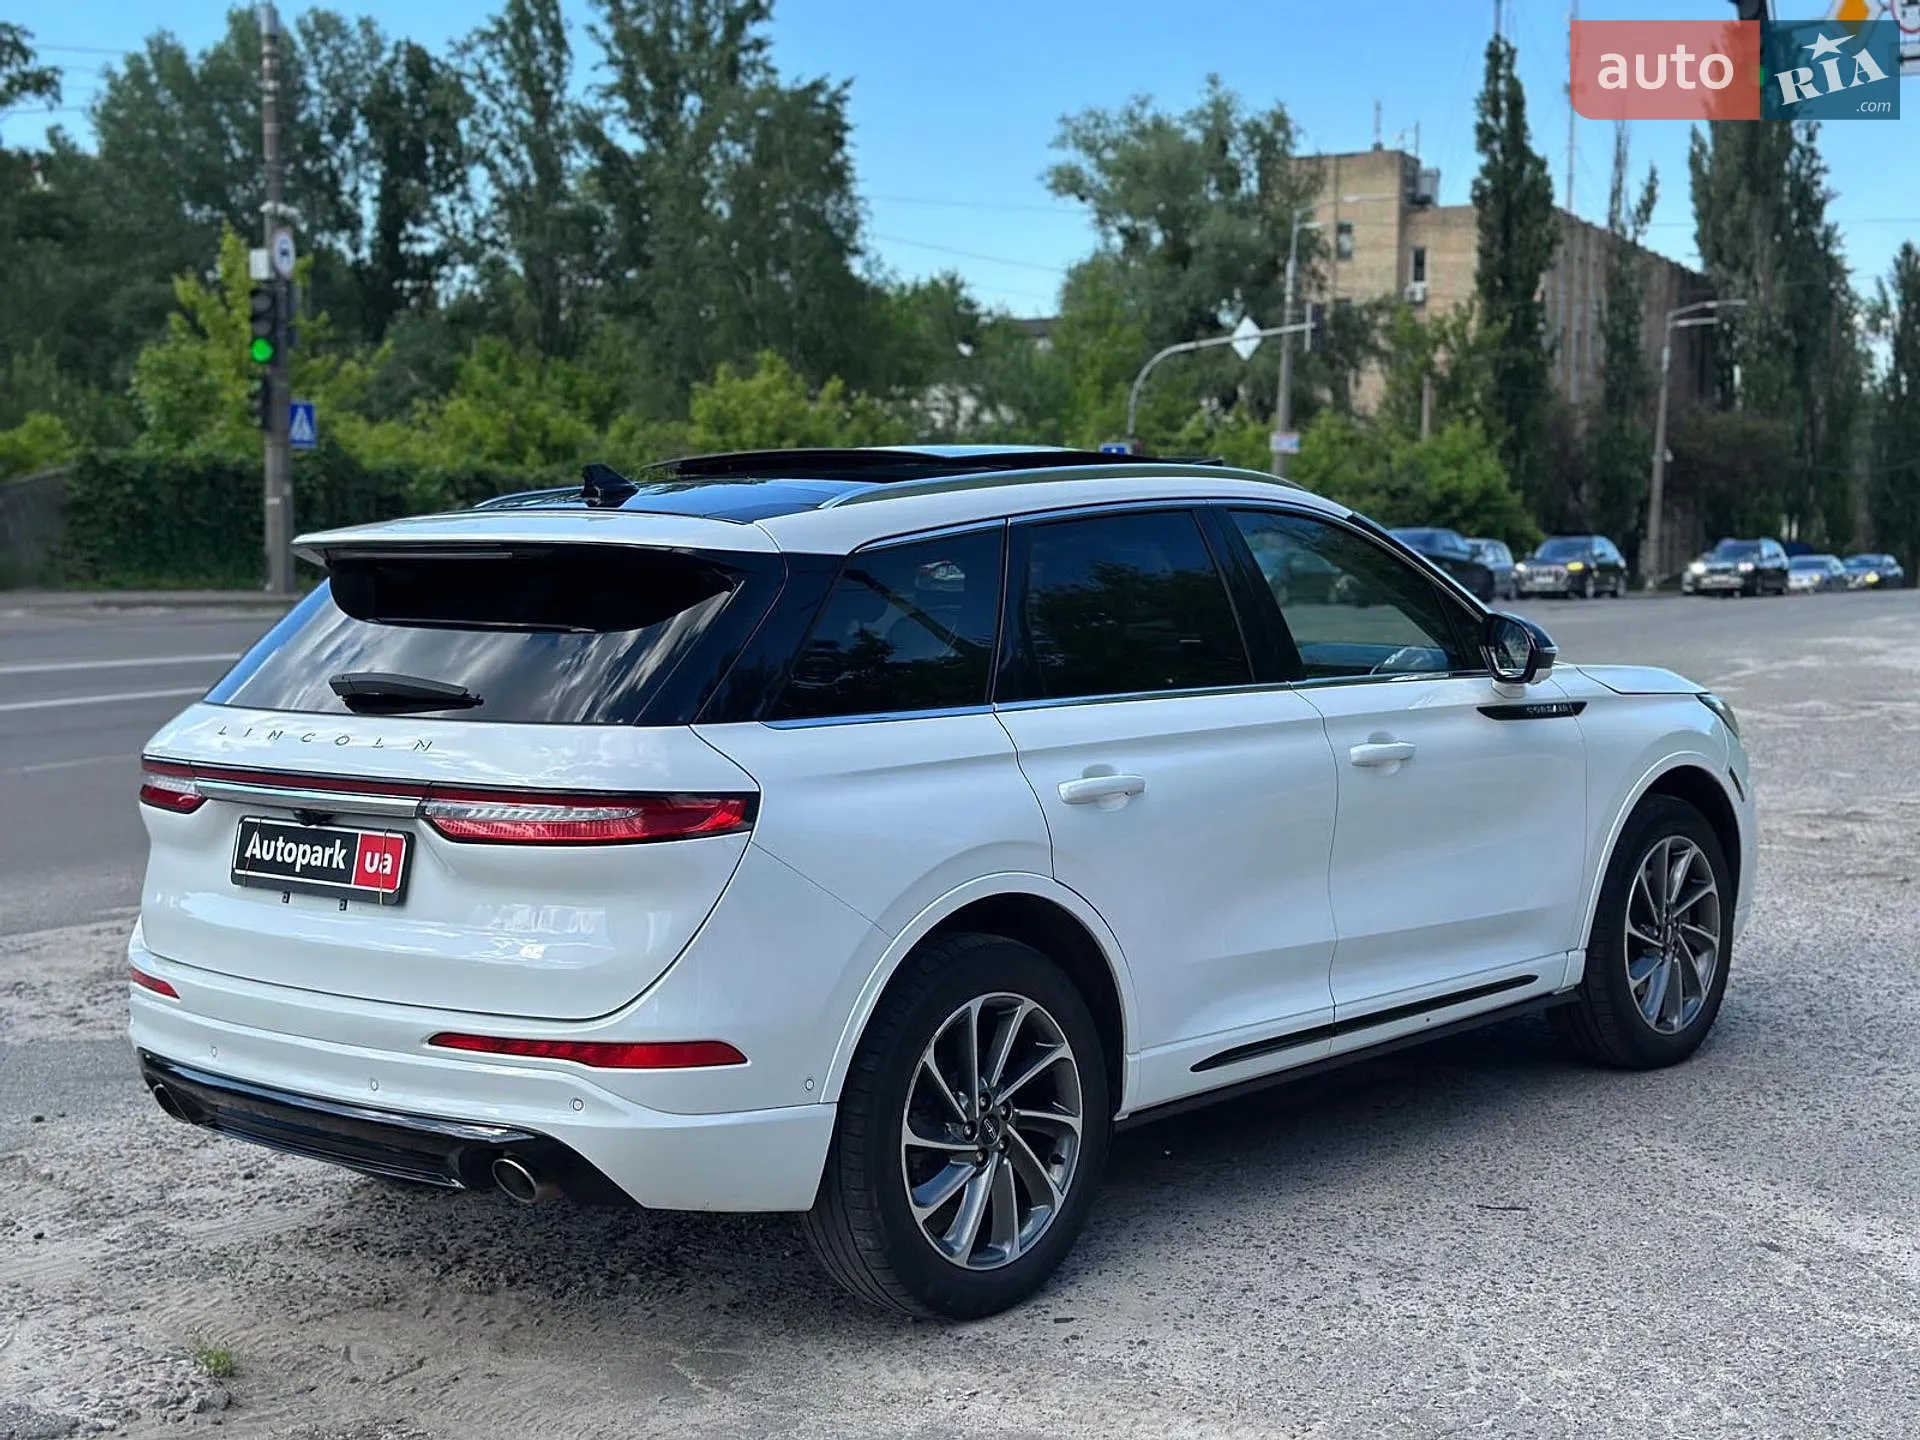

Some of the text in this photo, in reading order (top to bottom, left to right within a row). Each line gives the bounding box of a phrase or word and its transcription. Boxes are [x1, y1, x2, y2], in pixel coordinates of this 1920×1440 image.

[217, 726, 433, 752] LINCOLN
[245, 831, 393, 874] Autopark ua
